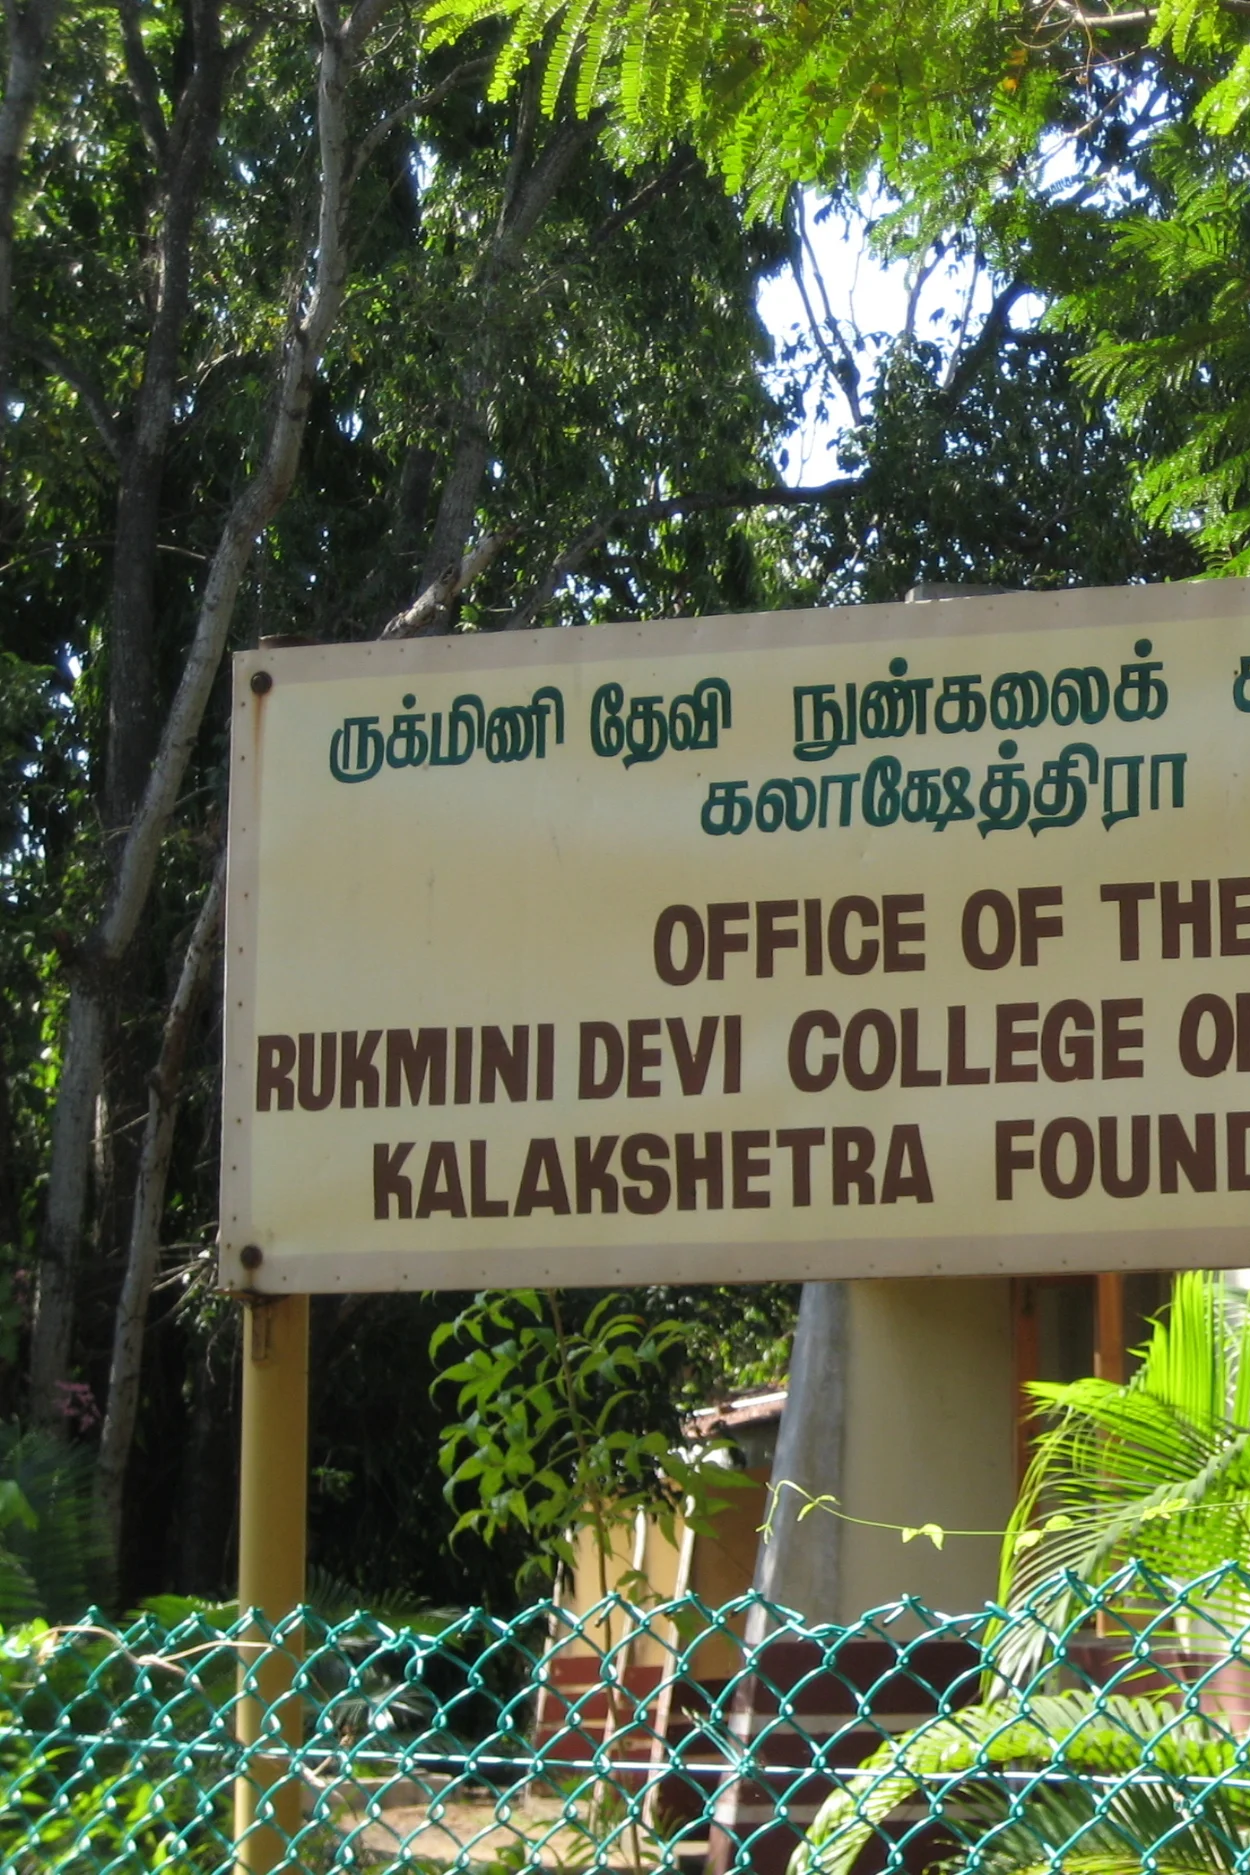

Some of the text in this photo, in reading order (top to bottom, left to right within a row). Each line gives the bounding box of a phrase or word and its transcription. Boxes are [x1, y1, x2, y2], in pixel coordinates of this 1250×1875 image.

[330, 686, 564, 784] ருக்மிணி
[590, 677, 732, 770] தேவி
[793, 638, 1168, 762] நுண்கலைக்
[701, 739, 1187, 840] கலாக்ஷேத்திரா
[654, 893, 925, 986] OFFICE
[961, 886, 1063, 970] OF
[256, 1023, 554, 1112] RUKMINI
[578, 1015, 741, 1100] DEVI
[788, 998, 1144, 1092] COLLEGE
[373, 1124, 934, 1220] KALAKSHETRA
